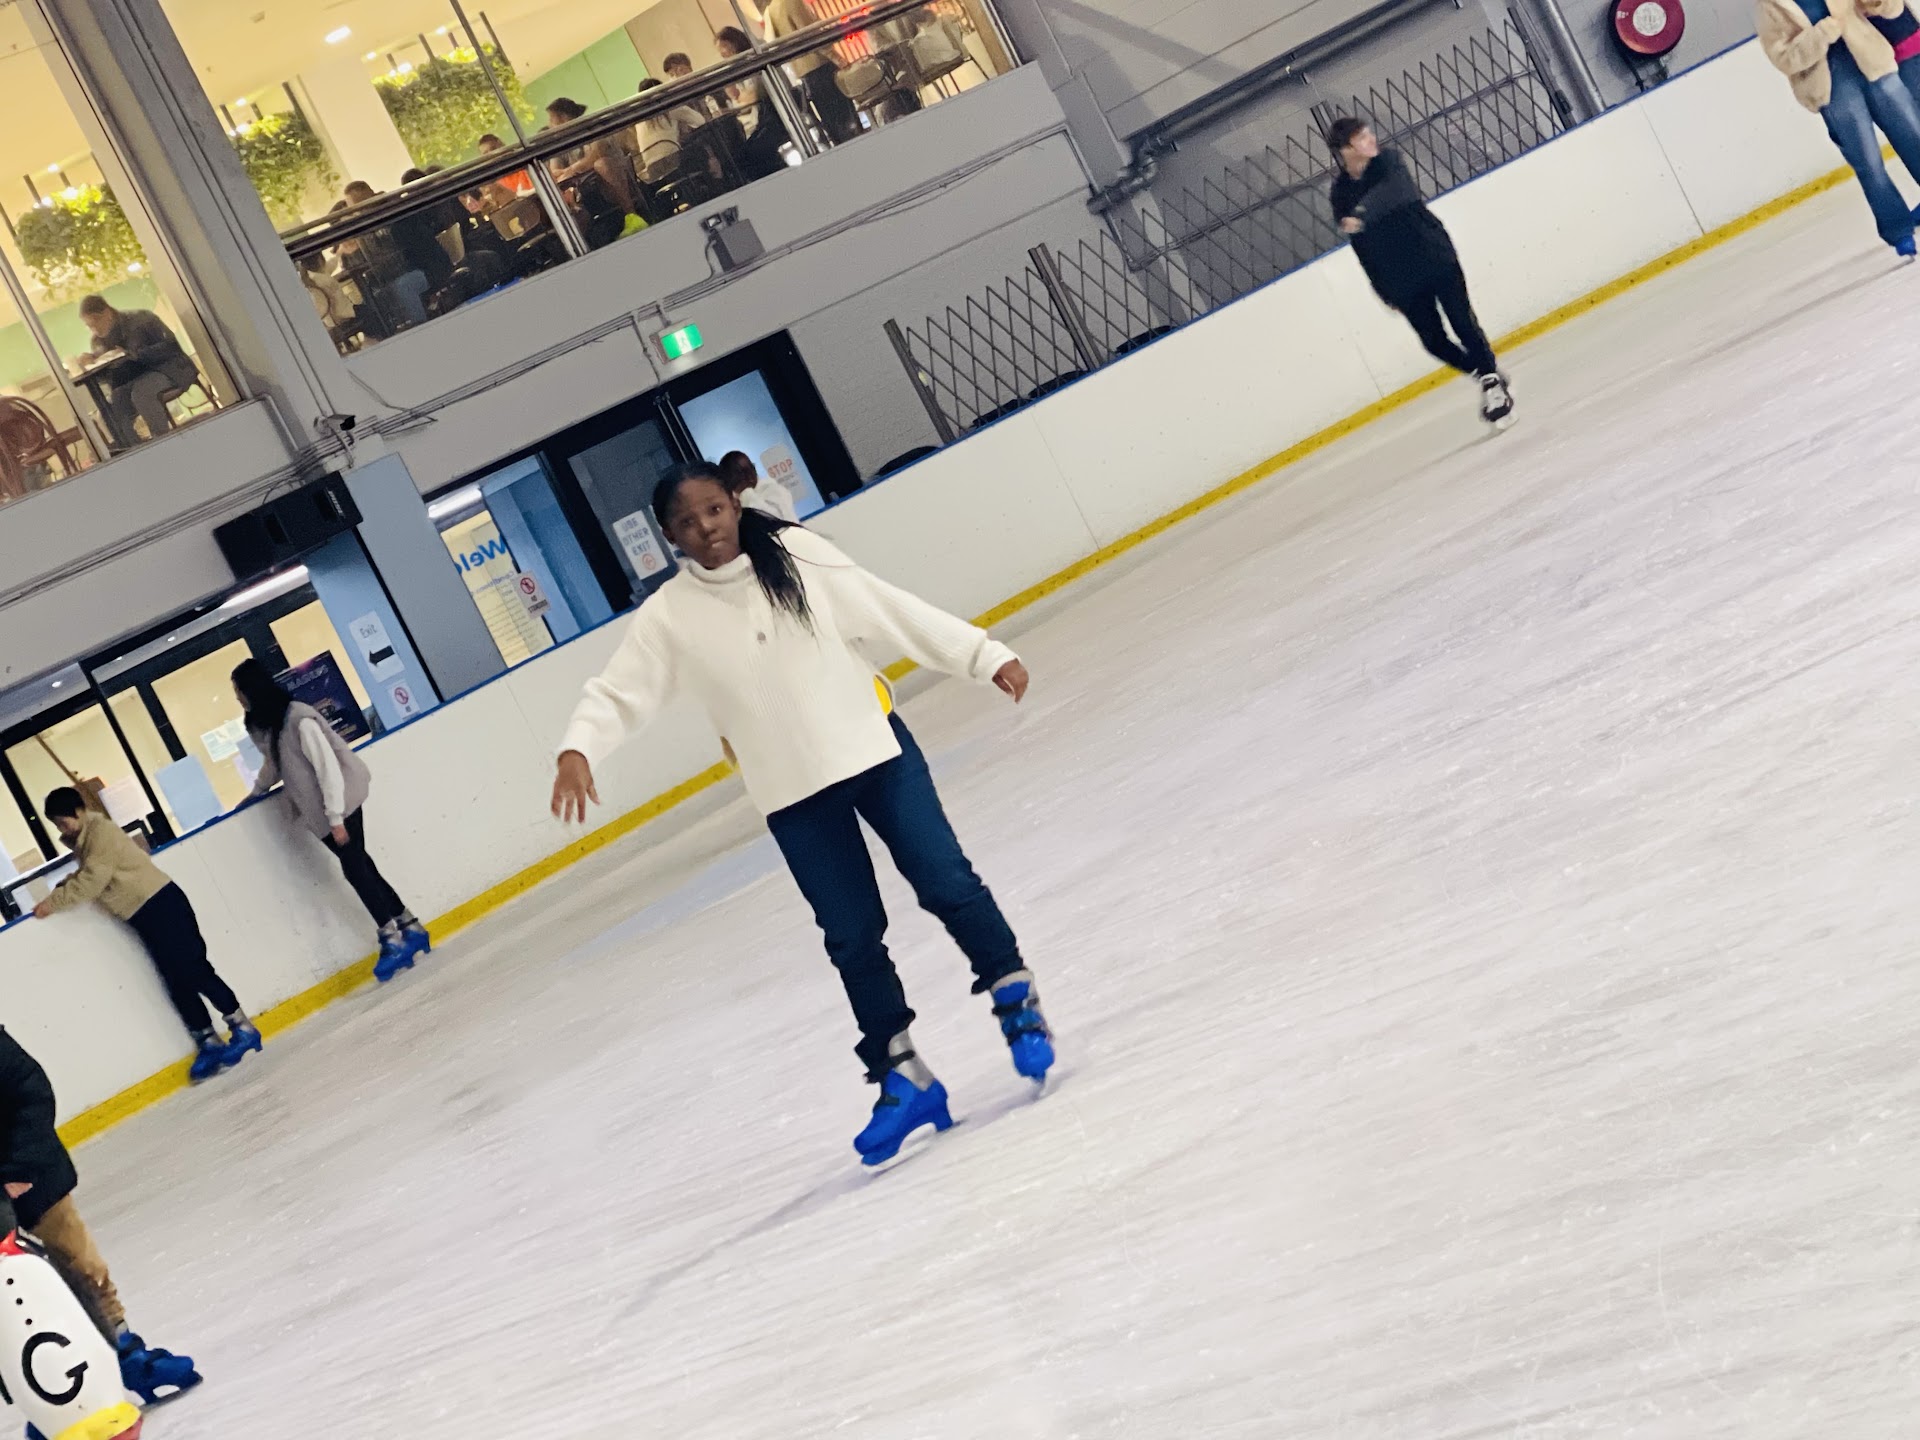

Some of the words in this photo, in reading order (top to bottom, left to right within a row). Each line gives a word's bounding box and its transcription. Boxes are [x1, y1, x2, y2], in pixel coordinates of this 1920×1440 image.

[768, 458, 793, 478] STOP
[622, 527, 650, 546] OTHER
[631, 541, 651, 556] EXIT
[0, 1331, 89, 1406] G
